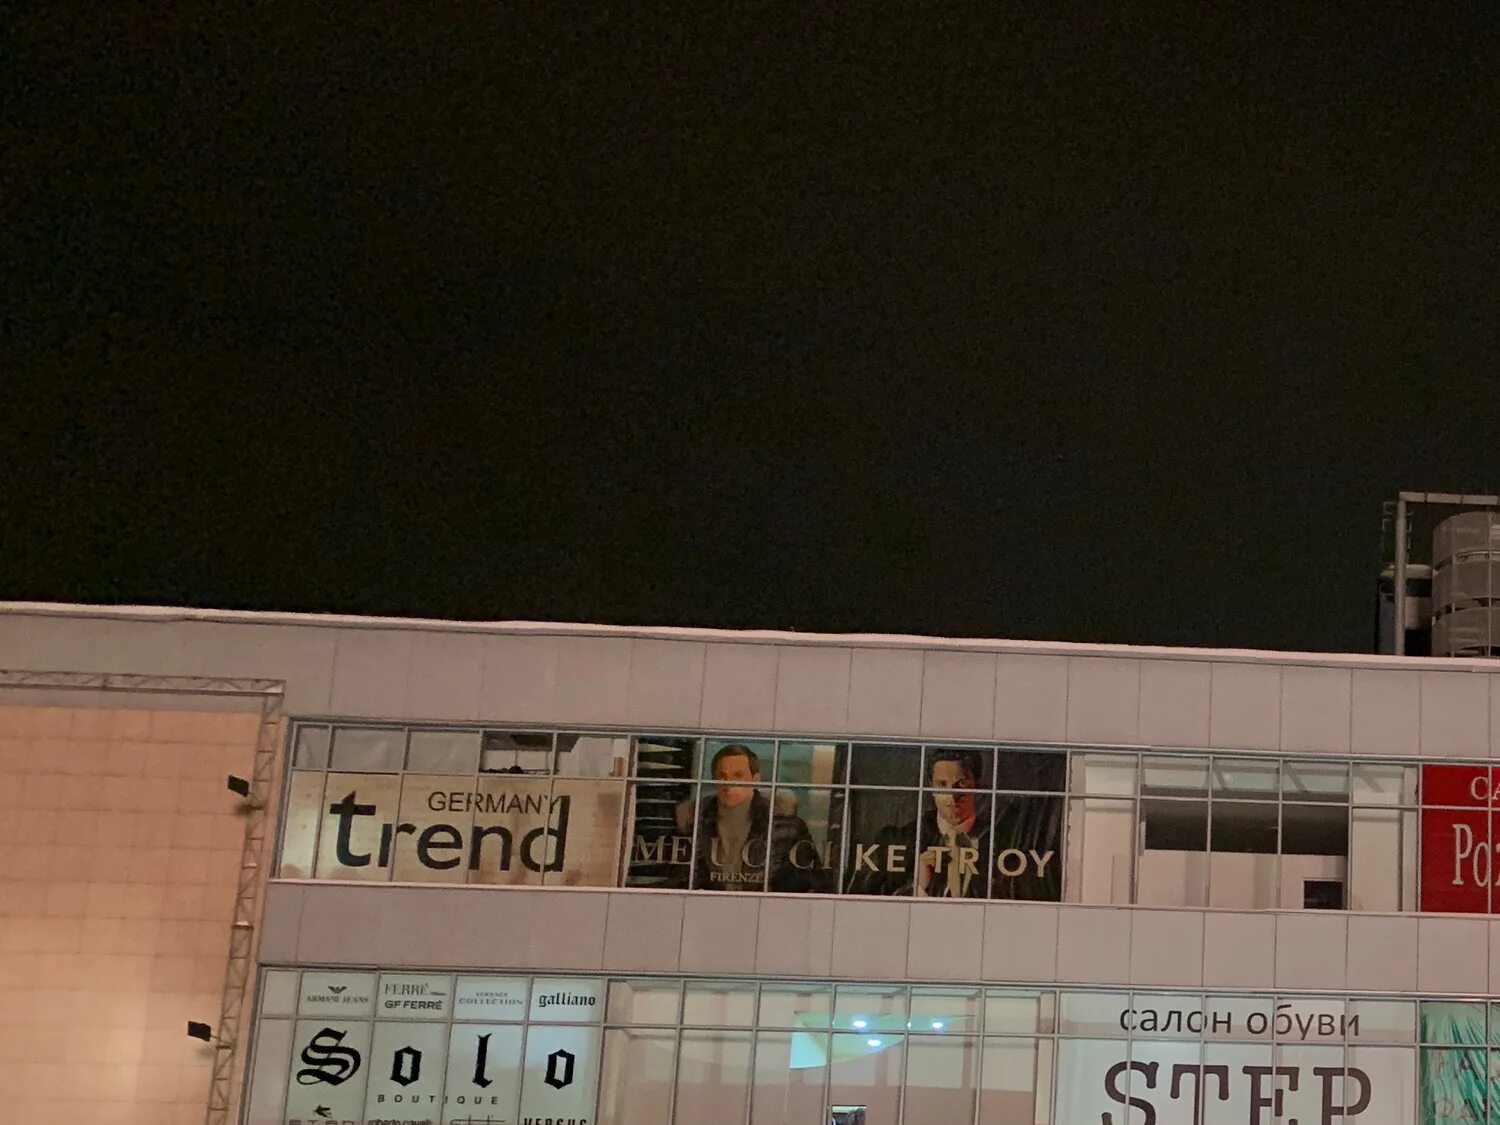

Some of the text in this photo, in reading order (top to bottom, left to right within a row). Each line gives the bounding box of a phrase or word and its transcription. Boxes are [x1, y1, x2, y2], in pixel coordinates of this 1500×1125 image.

[428, 790, 561, 815] GERMANY
[329, 790, 571, 873] trend
[539, 992, 596, 1007] galliano
[1119, 1003, 1360, 1040] салон обуви
[296, 1027, 576, 1090] Solo
[377, 1094, 499, 1105] BOUTIQUE
